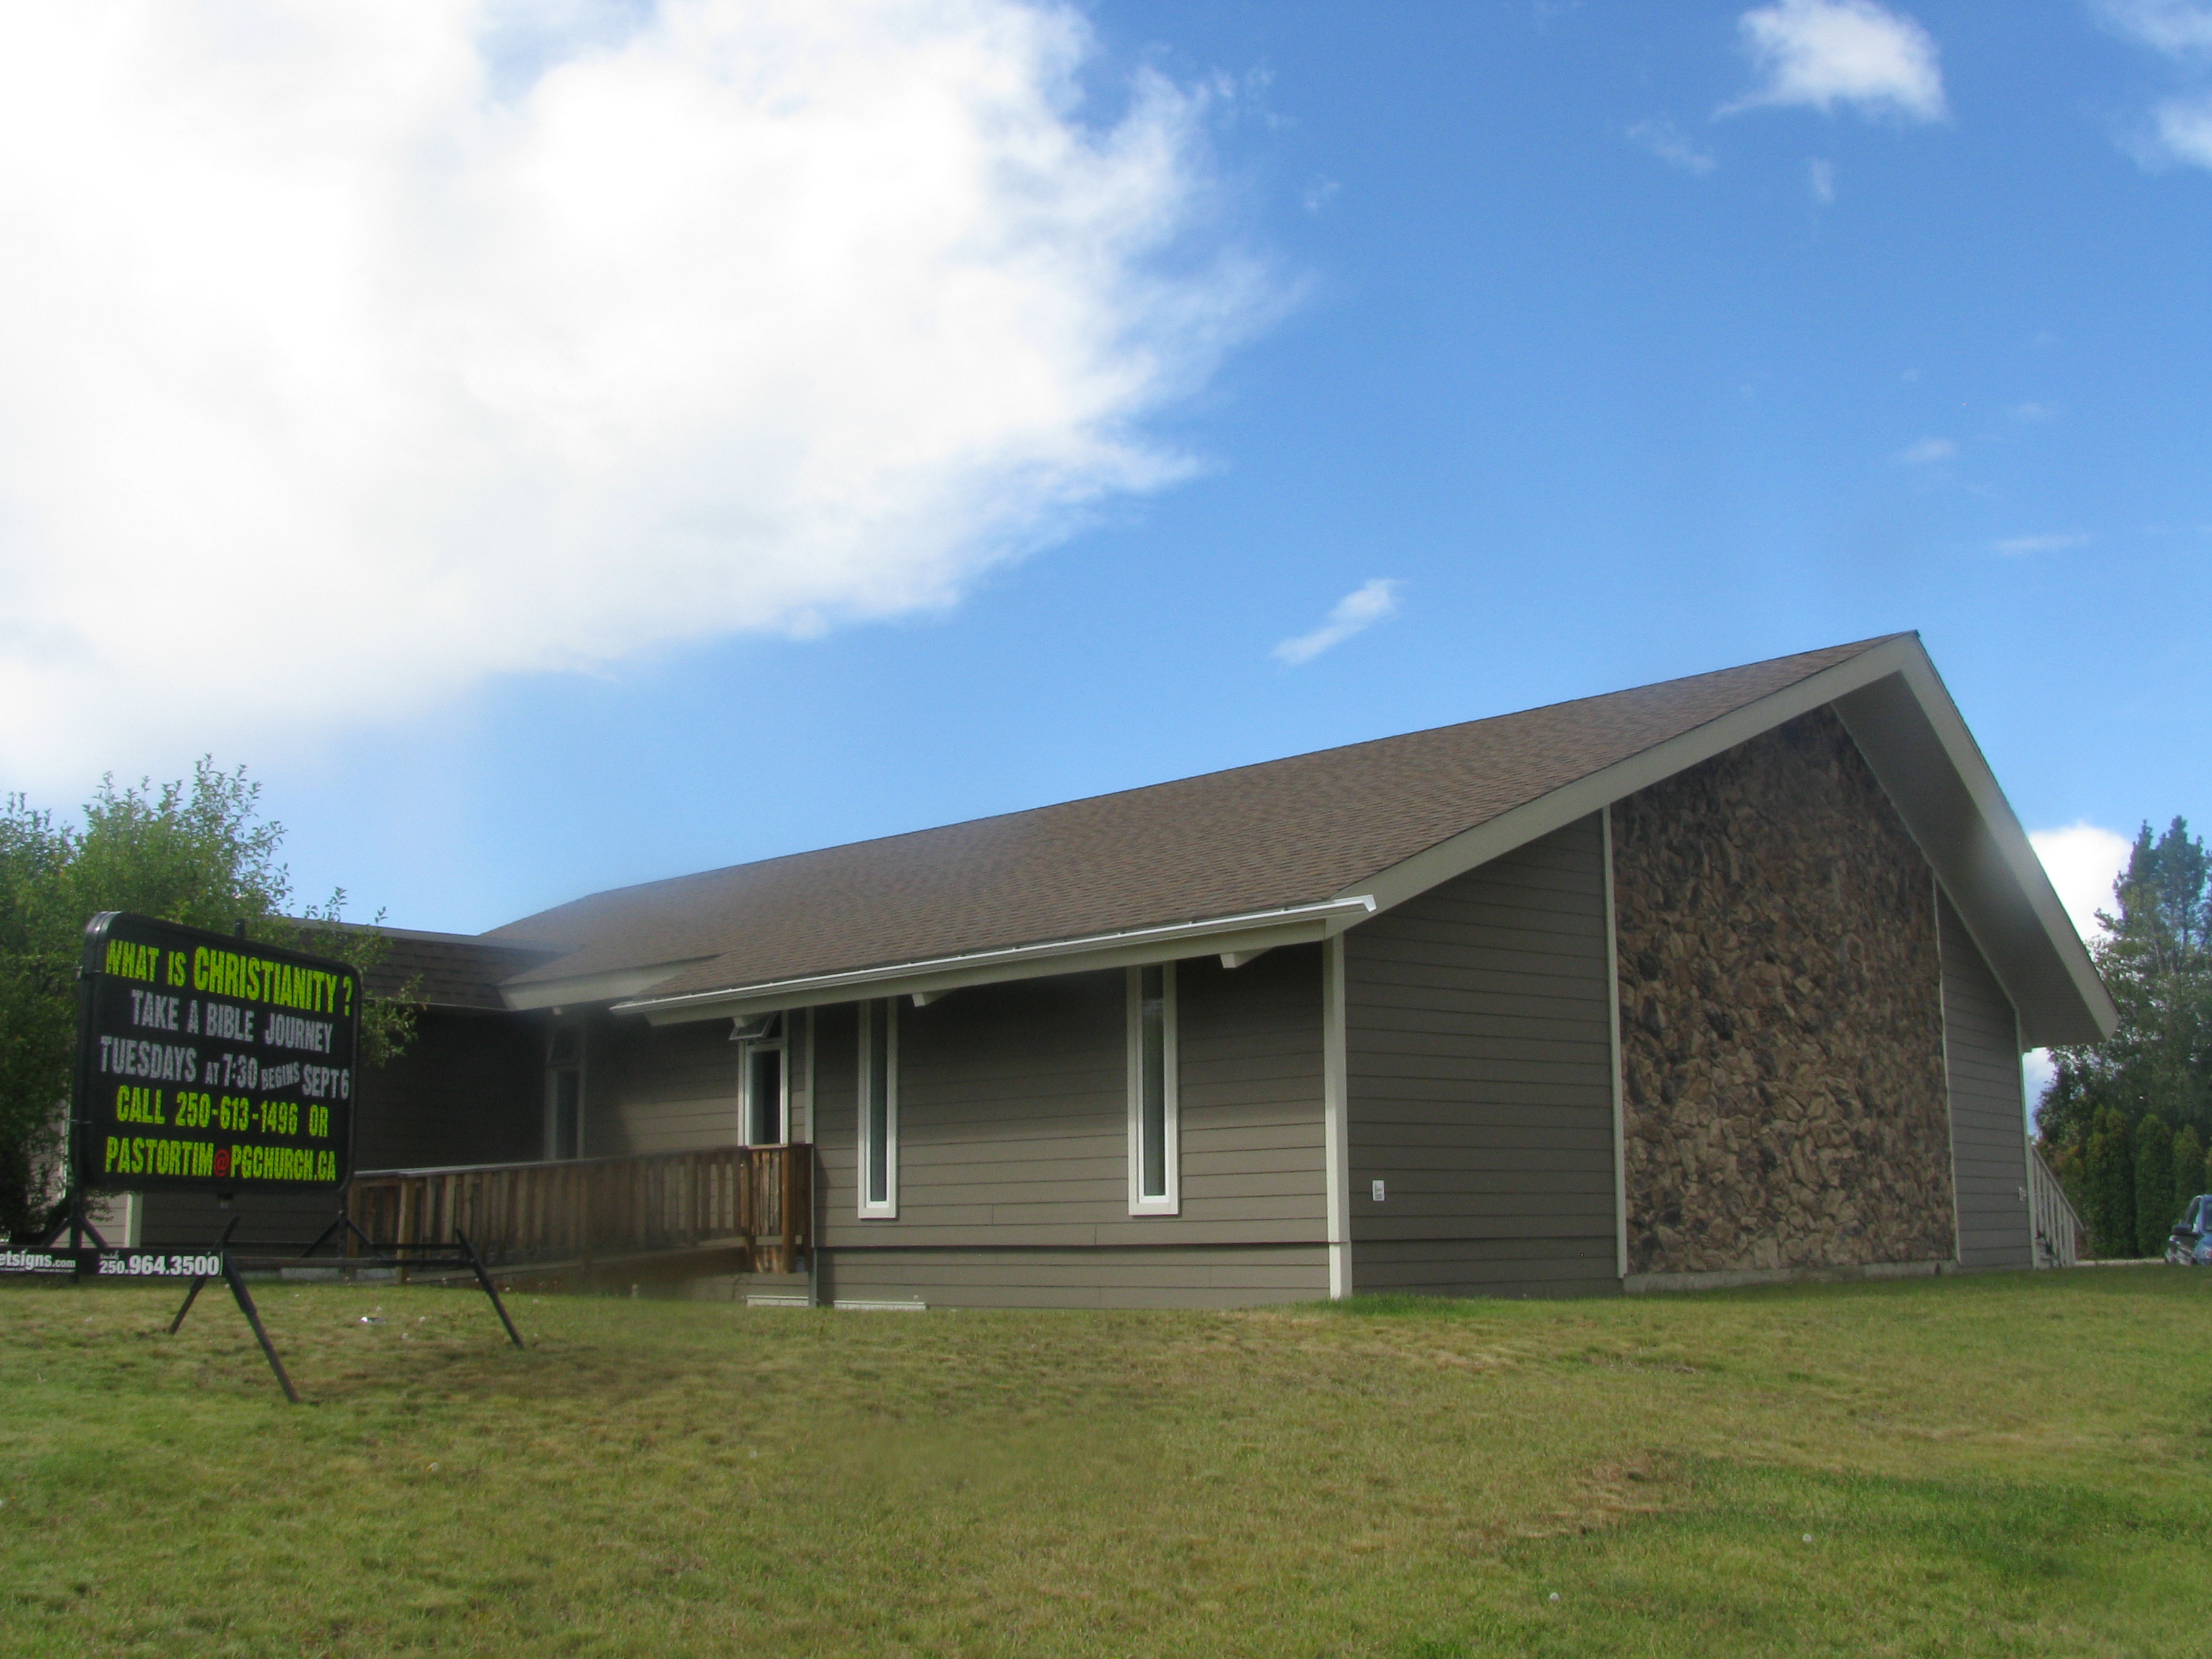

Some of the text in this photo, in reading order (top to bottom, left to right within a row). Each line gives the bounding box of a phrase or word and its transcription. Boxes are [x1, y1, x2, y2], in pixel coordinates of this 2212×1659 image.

[105, 939, 160, 983] WHAT
[167, 950, 188, 987] IS
[194, 945, 338, 1014] CHRISTIANITY
[131, 989, 333, 1054] TAKE A BIBLE JOURNEY
[100, 1035, 350, 1099] TUESDAYS AT 7:30 BEGINS SEPT 6
[116, 1085, 329, 1138] CALL 250-613-1496 OR
[104, 1136, 337, 1182] PASTORTIM@PGCHURCH.CA
[99, 1254, 219, 1275] 250.964.3500
